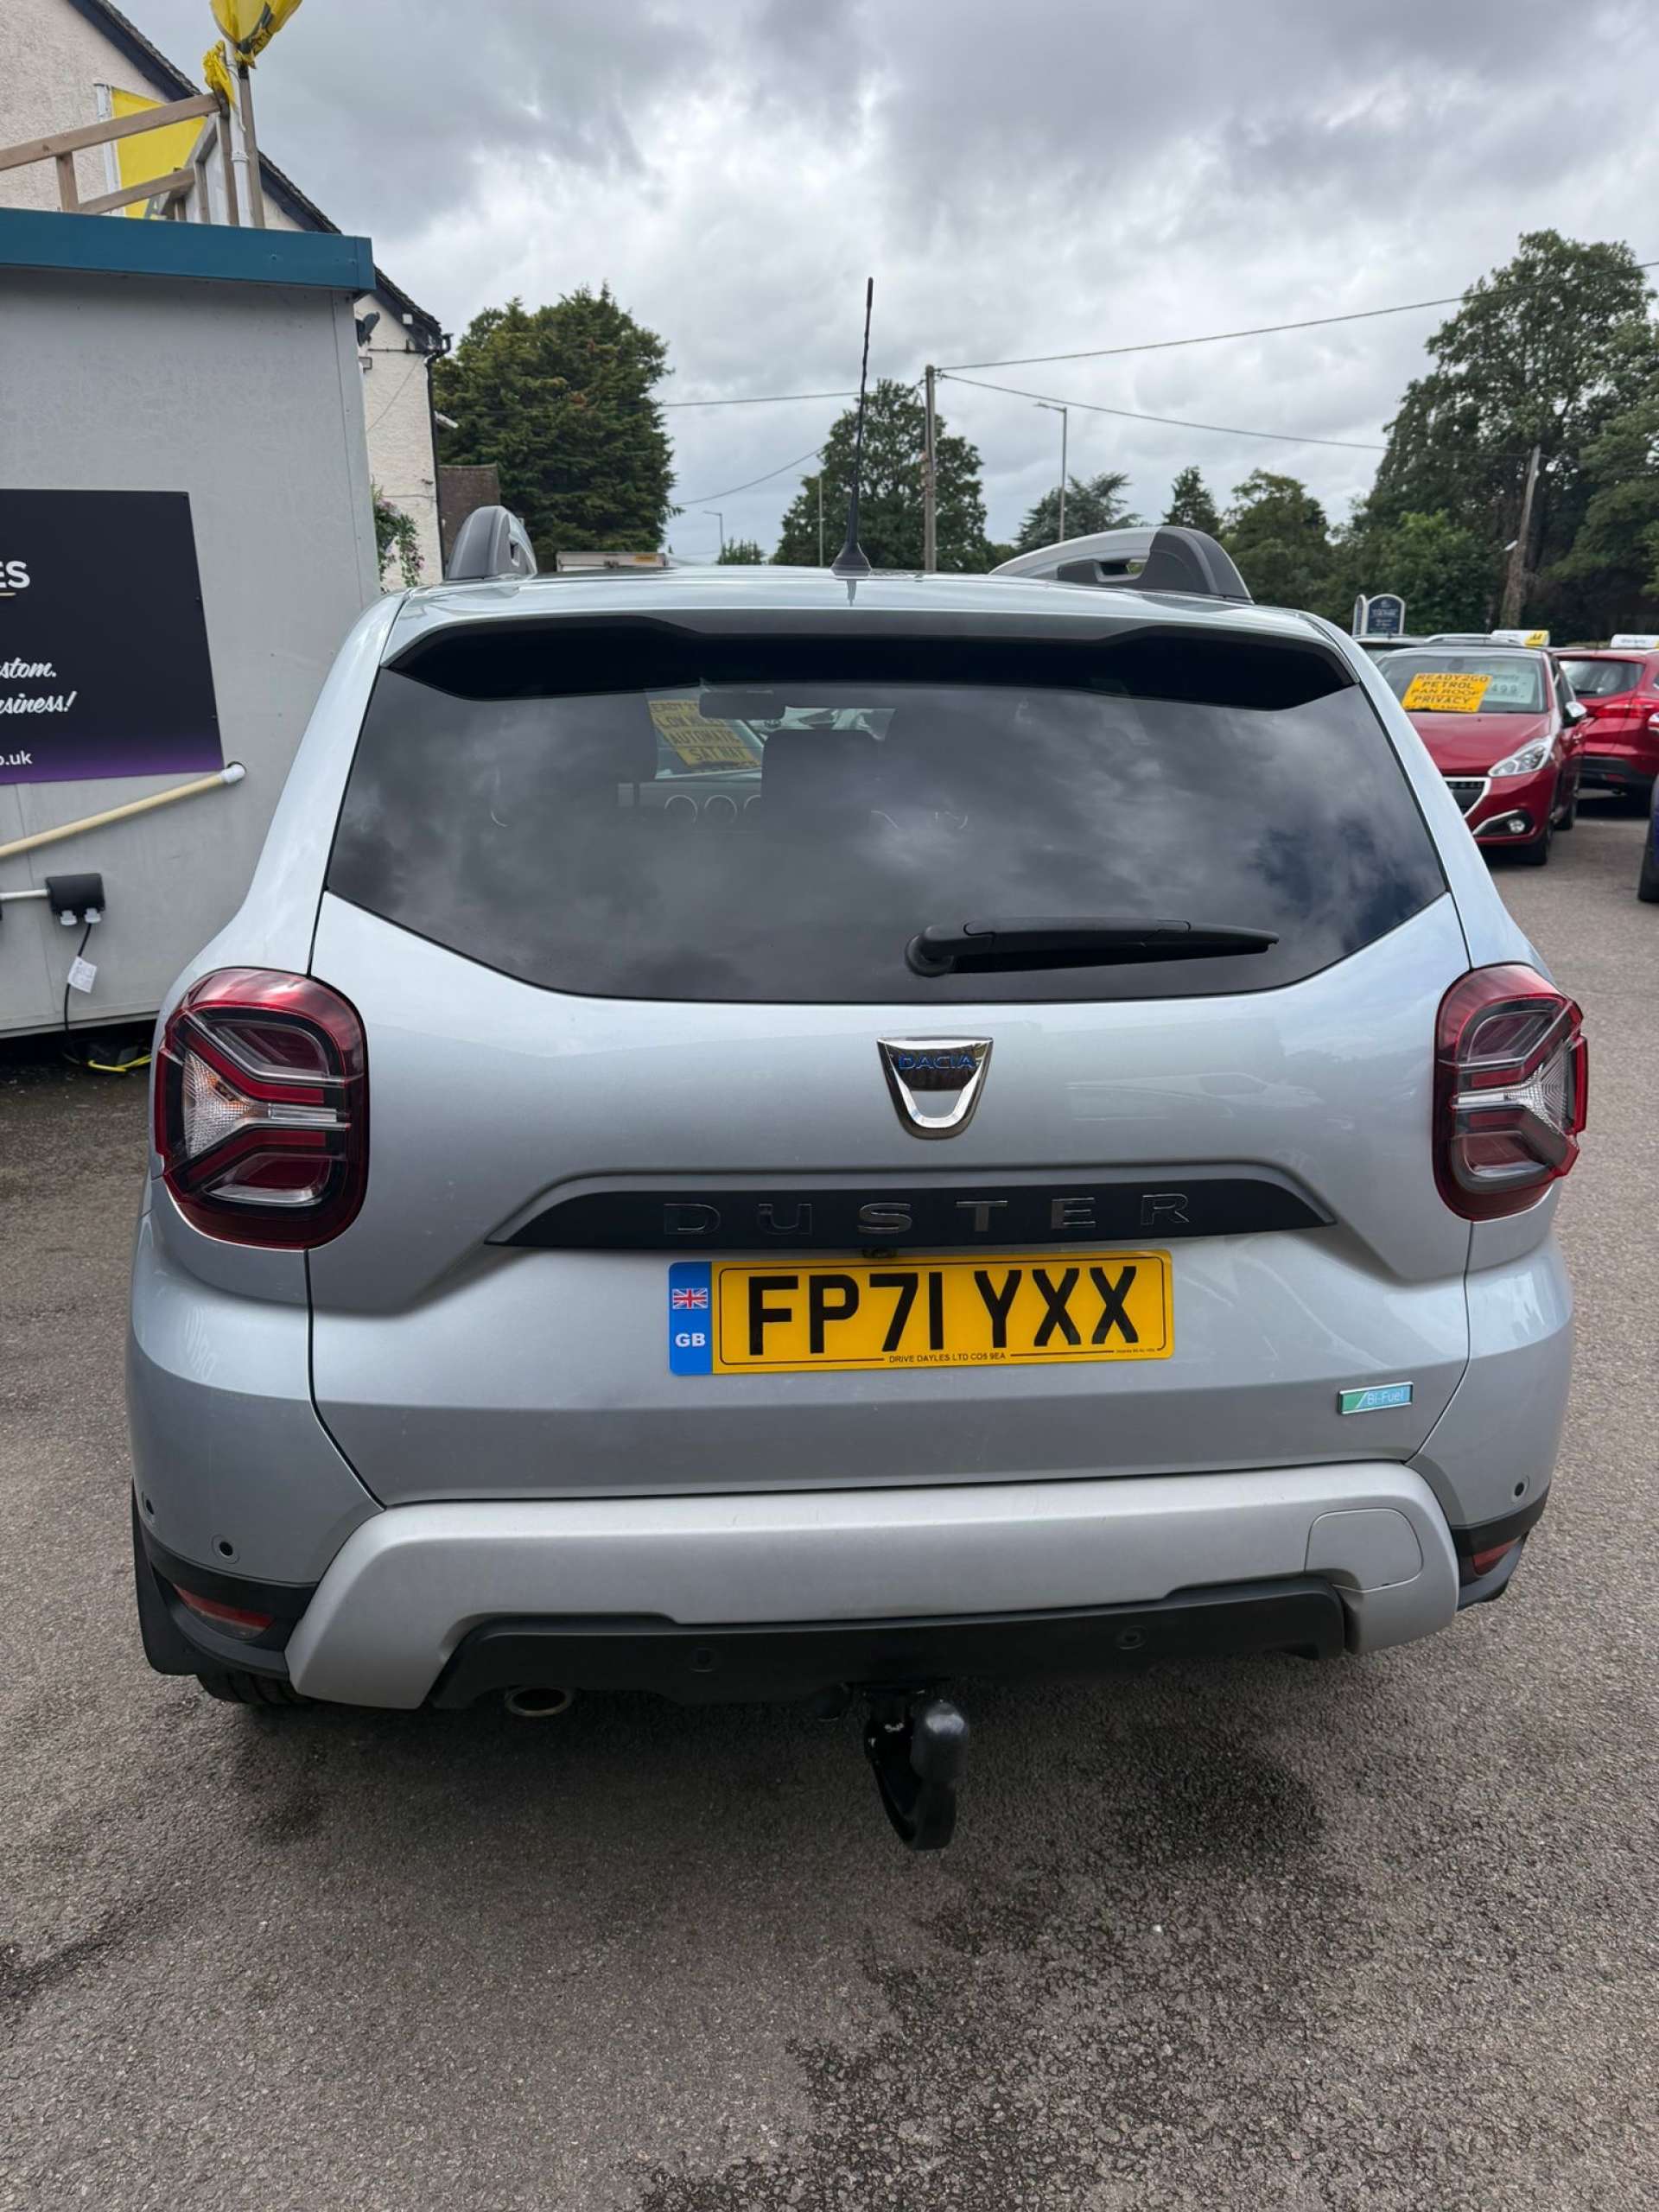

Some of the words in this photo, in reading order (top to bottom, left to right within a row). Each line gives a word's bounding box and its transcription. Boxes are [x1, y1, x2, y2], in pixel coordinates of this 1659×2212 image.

[899, 1054, 976, 1069] DACIA
[664, 1193, 1190, 1235] DUSTER
[749, 1272, 944, 1355] FP71
[975, 1267, 1138, 1348] YXX
[675, 1332, 706, 1347] GB
[889, 1354, 914, 1363] DRIVE
[917, 1353, 950, 1362] DAYLES
[952, 1353, 969, 1362] LTD
